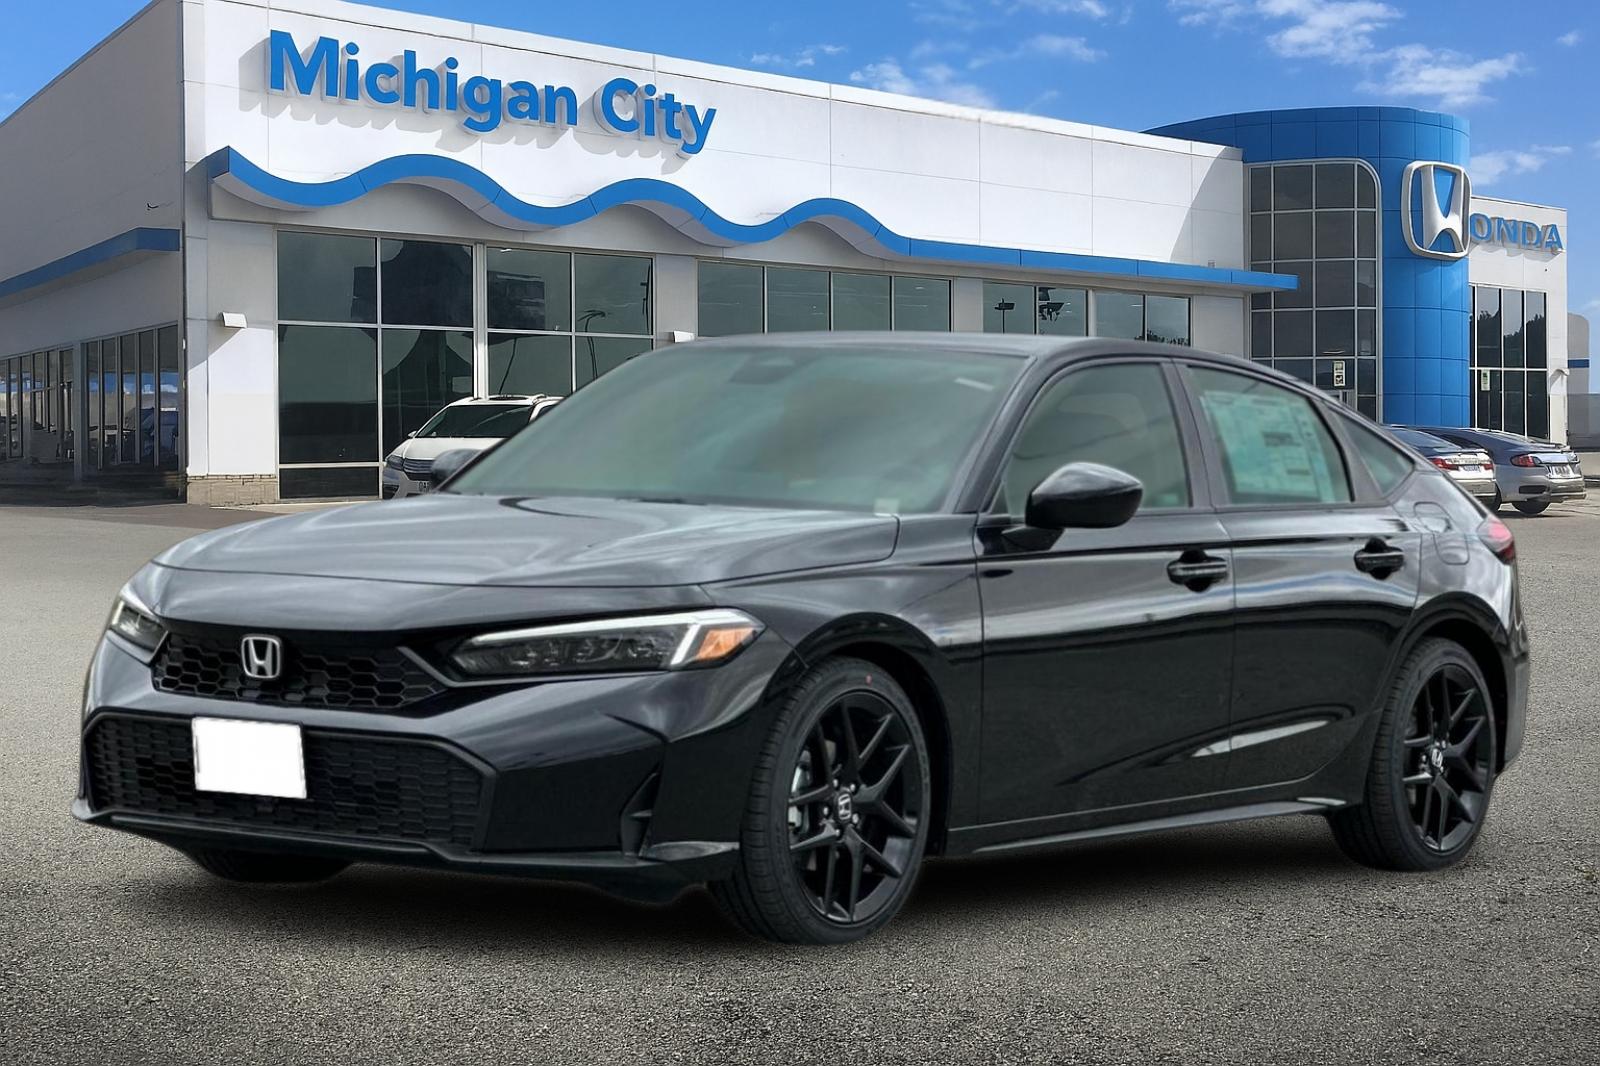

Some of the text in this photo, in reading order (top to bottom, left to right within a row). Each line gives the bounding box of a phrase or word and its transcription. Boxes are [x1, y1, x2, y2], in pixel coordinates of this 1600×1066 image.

[270, 29, 717, 154] Michigan City
[1469, 212, 1564, 250] ONDA
